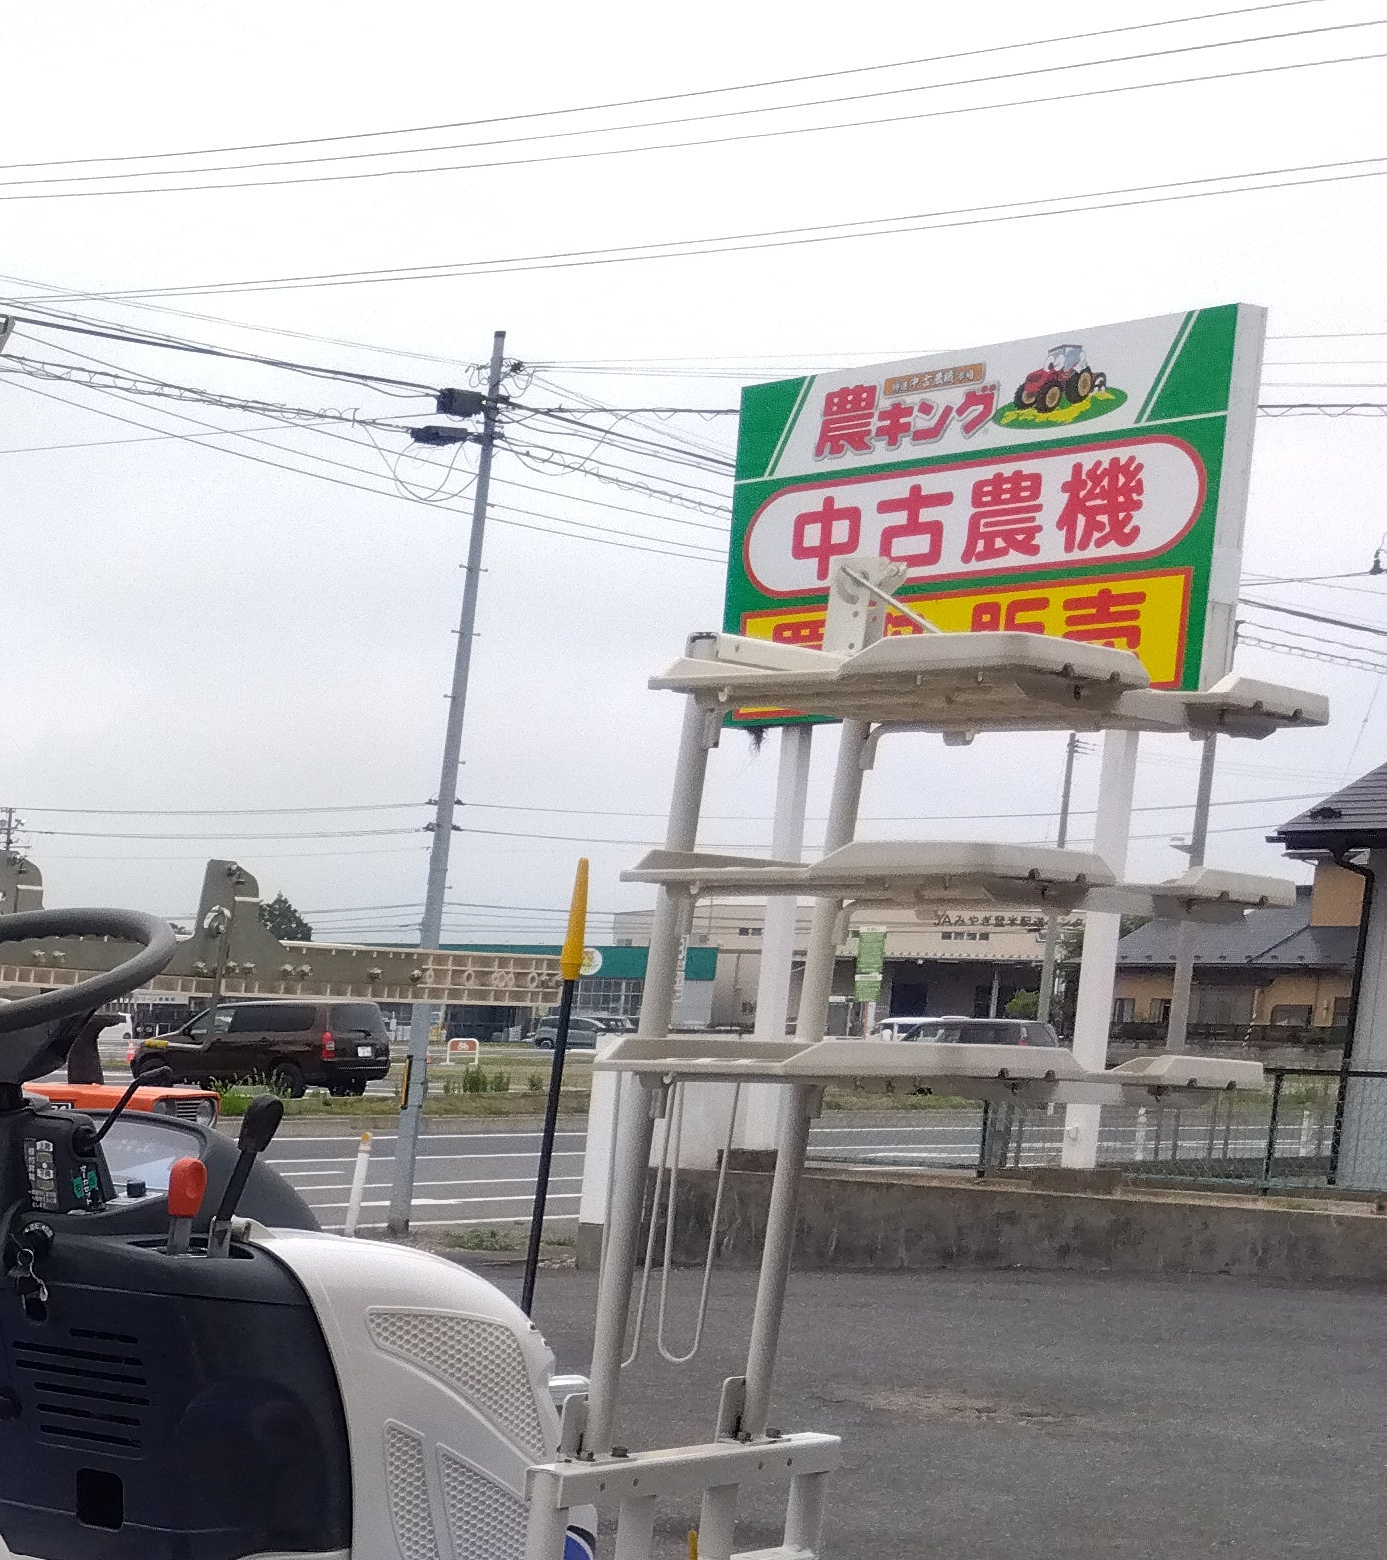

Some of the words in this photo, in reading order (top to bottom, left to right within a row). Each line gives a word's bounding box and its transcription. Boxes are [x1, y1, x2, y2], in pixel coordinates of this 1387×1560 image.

[814, 384, 997, 459] 農キング
[791, 455, 1145, 581] 中古農機
